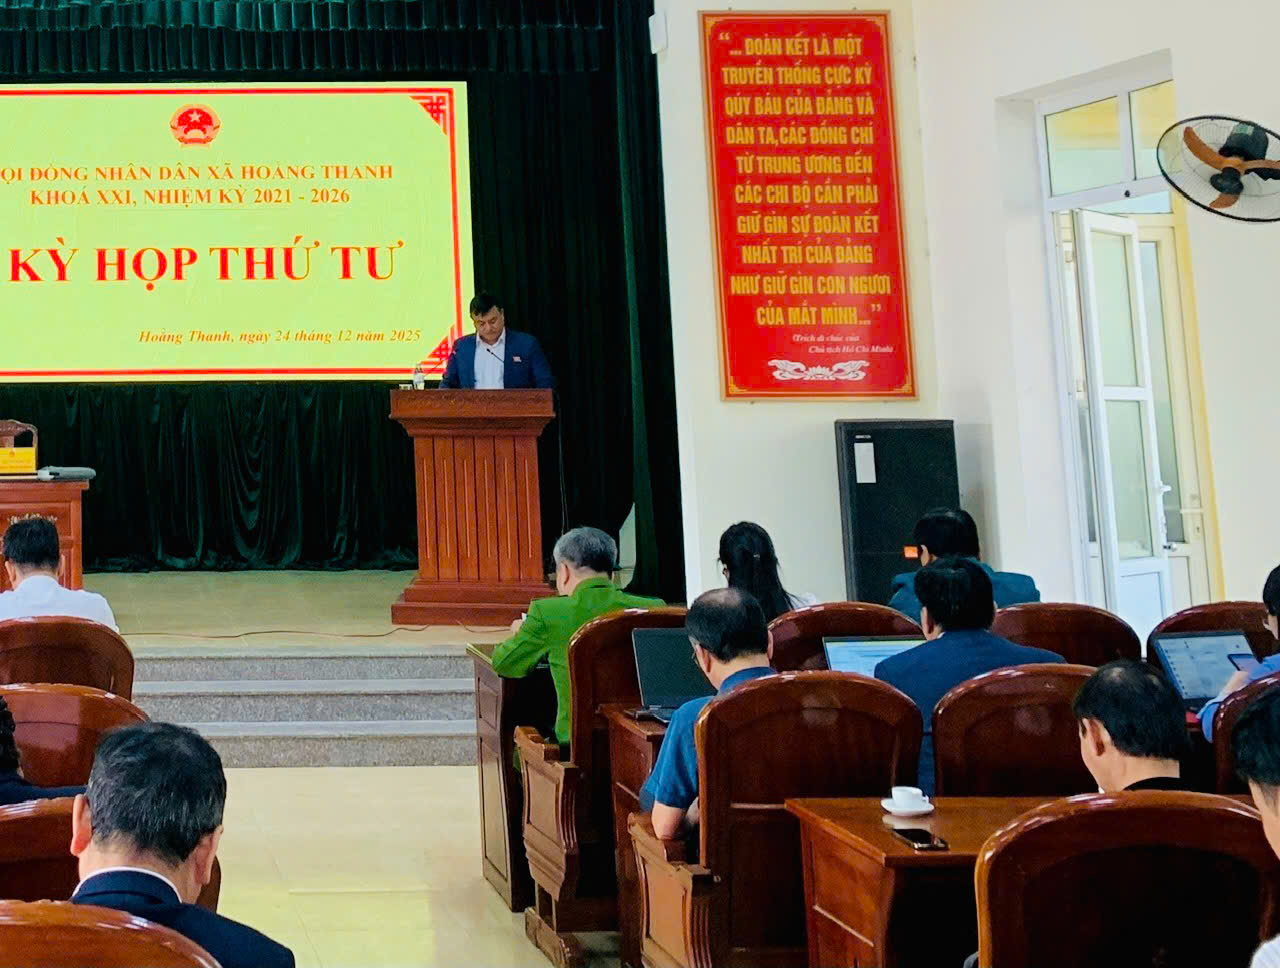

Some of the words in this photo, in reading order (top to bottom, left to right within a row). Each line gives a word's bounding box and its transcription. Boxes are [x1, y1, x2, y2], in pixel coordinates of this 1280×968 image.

[785, 31, 810, 55] KẾT
[813, 33, 830, 55] LÀ
[856, 92, 874, 115] VÀ
[779, 121, 806, 144] CÁC
[95, 162, 152, 181] NHÂN
[159, 162, 200, 181] DÂN
[208, 162, 234, 180] XÃ
[321, 165, 393, 180] THANH
[756, 156, 801, 173] TRUNG
[805, 155, 842, 173] ƯƠNG
[31, 185, 90, 205] KHOÁ
[96, 190, 137, 207] XXI,
[254, 189, 291, 203] 2021
[312, 188, 350, 203] 2026
[735, 180, 762, 203] CÁC
[766, 185, 789, 203] CHI
[855, 209, 879, 233] KẾT
[8, 237, 79, 282] KỲ
[94, 247, 198, 291] HỌP
[209, 235, 320, 280] THỨ
[331, 240, 404, 280] TƯ
[731, 274, 760, 294] NHƯ
[817, 276, 845, 294] CON
[189, 330, 234, 343] Thanh,
[239, 332, 271, 345] ngày
[275, 331, 290, 341] 24
[294, 330, 332, 344] tháng
[338, 330, 352, 341] 12
[389, 330, 421, 341] 2025
